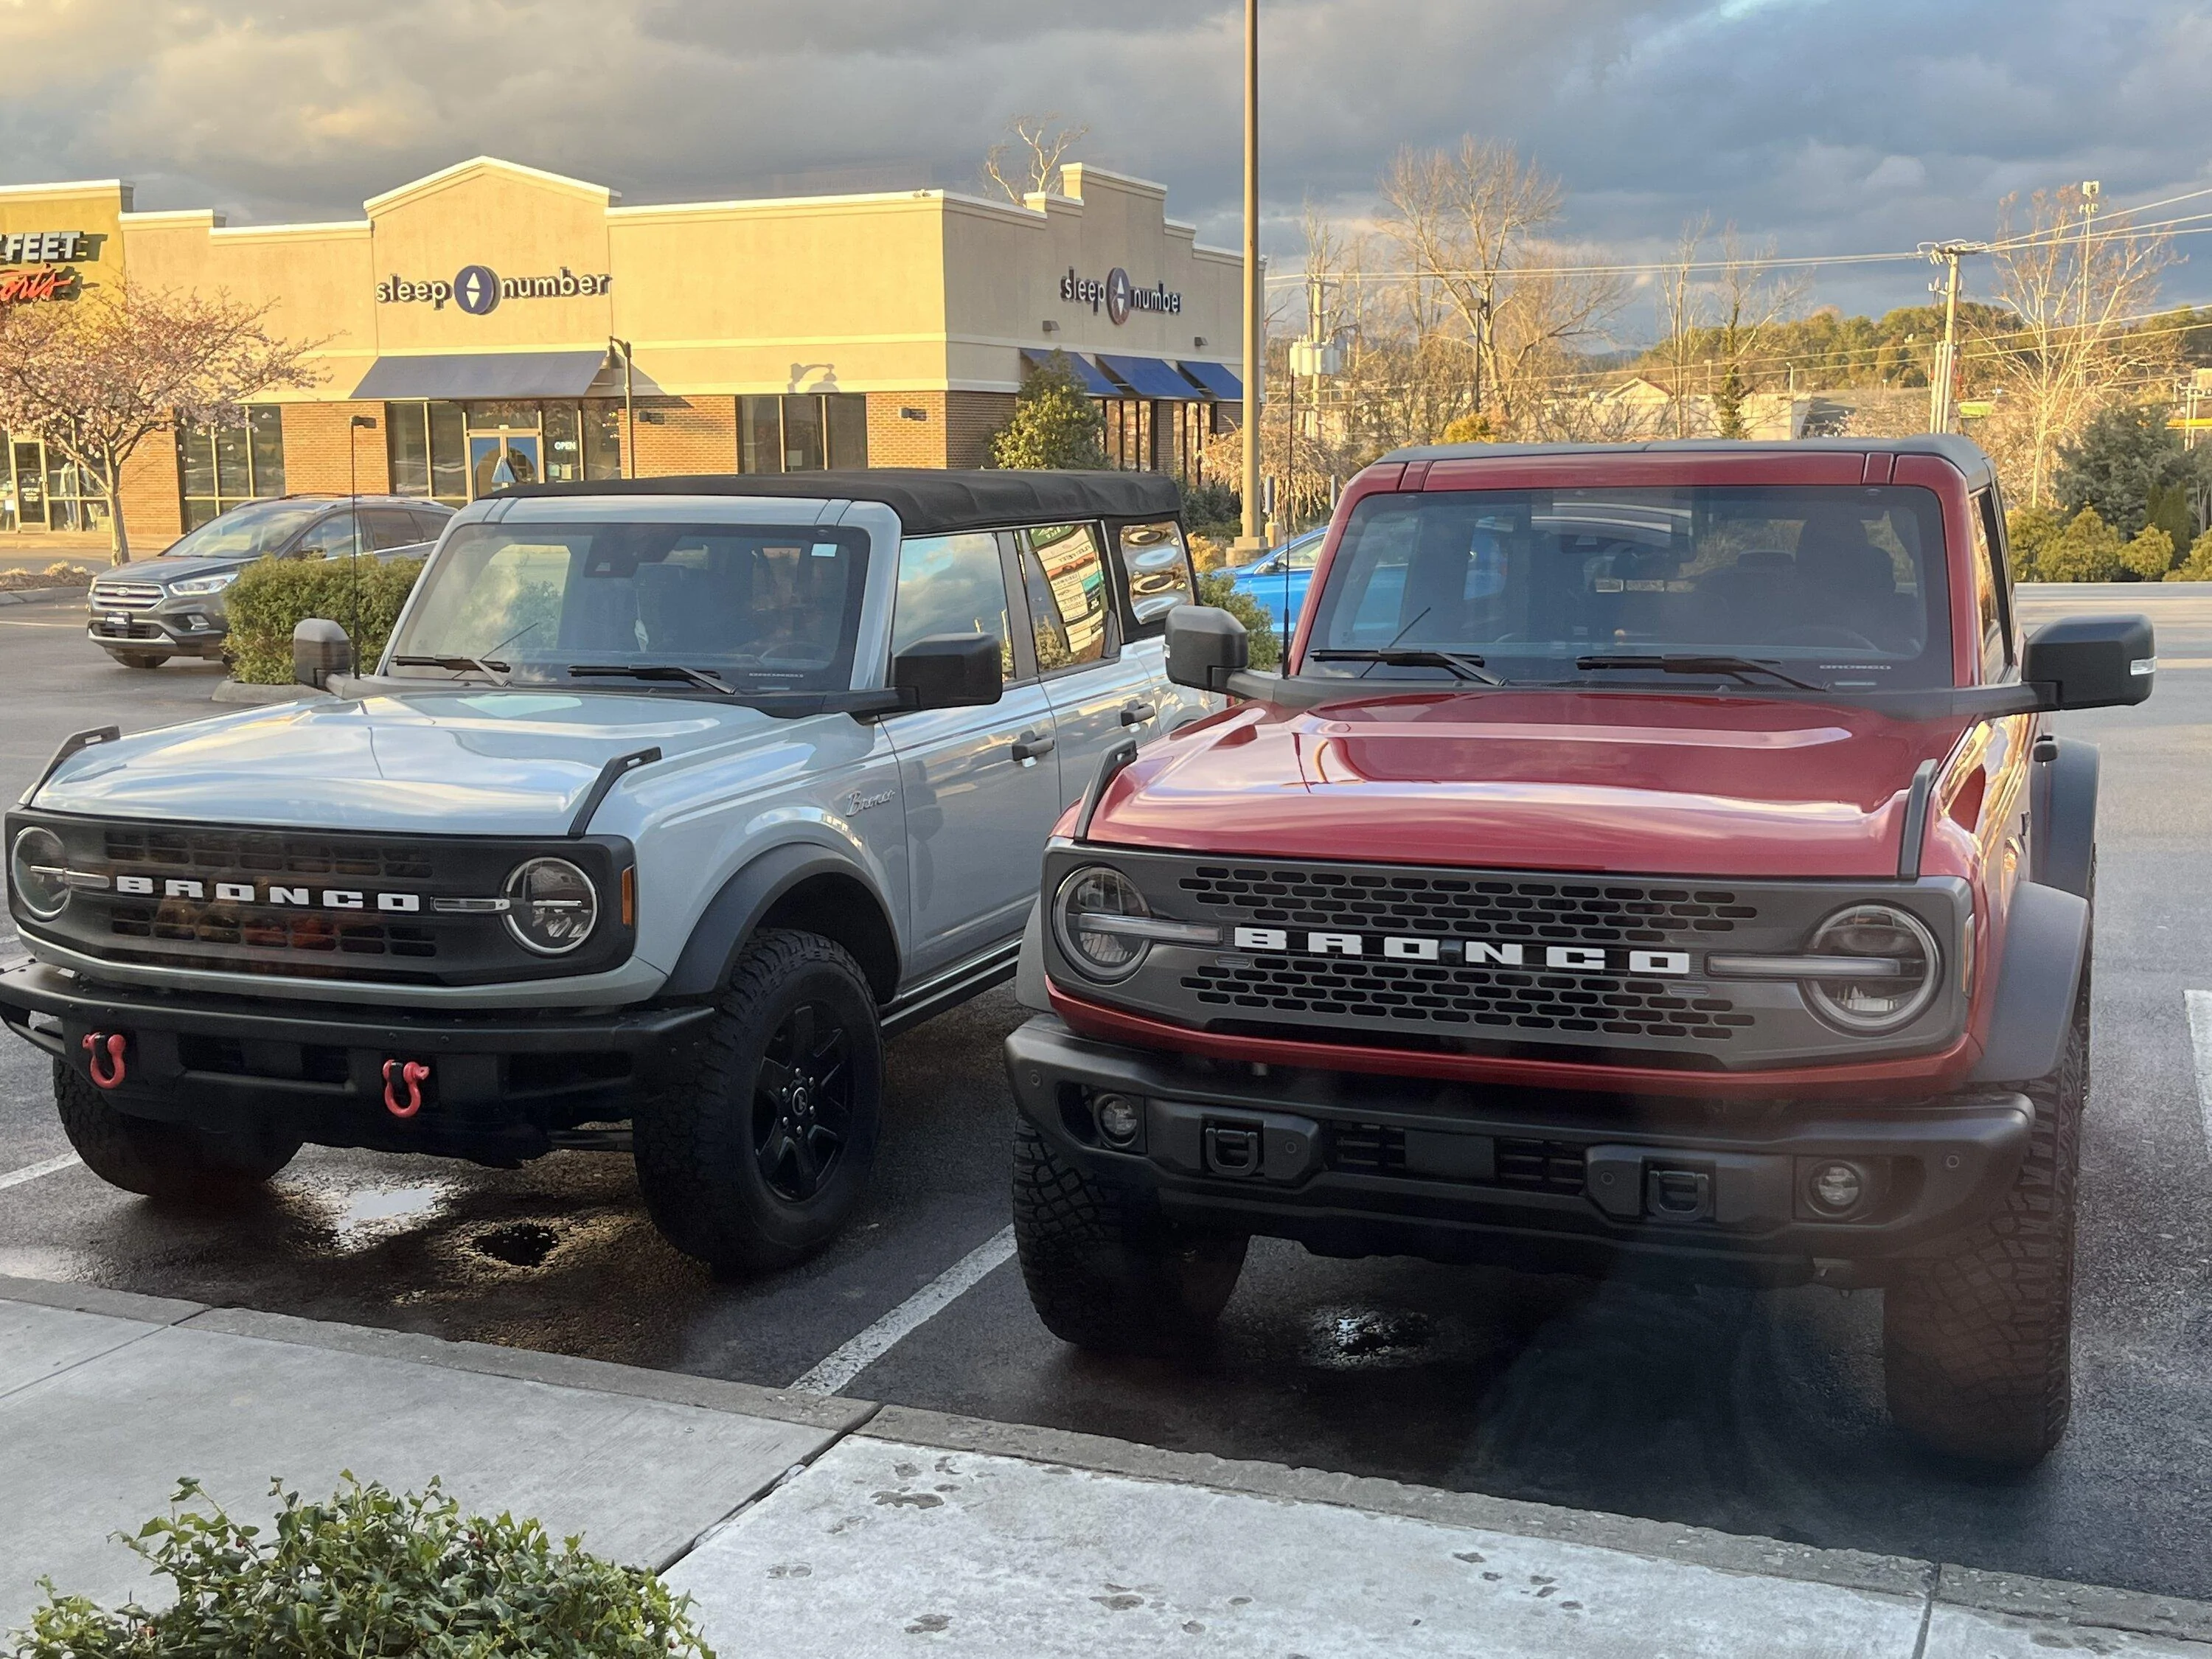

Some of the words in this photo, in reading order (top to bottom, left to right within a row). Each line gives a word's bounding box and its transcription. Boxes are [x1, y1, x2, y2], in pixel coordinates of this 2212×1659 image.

[5, 231, 81, 261] FEET
[375, 273, 451, 310] sleep
[501, 266, 612, 299] number
[1060, 266, 1106, 315] sleep
[554, 441, 576, 451] OPEN
[846, 790, 895, 816] Bronco
[116, 875, 420, 911] BRONCO
[1234, 927, 1690, 975] BRONCO
